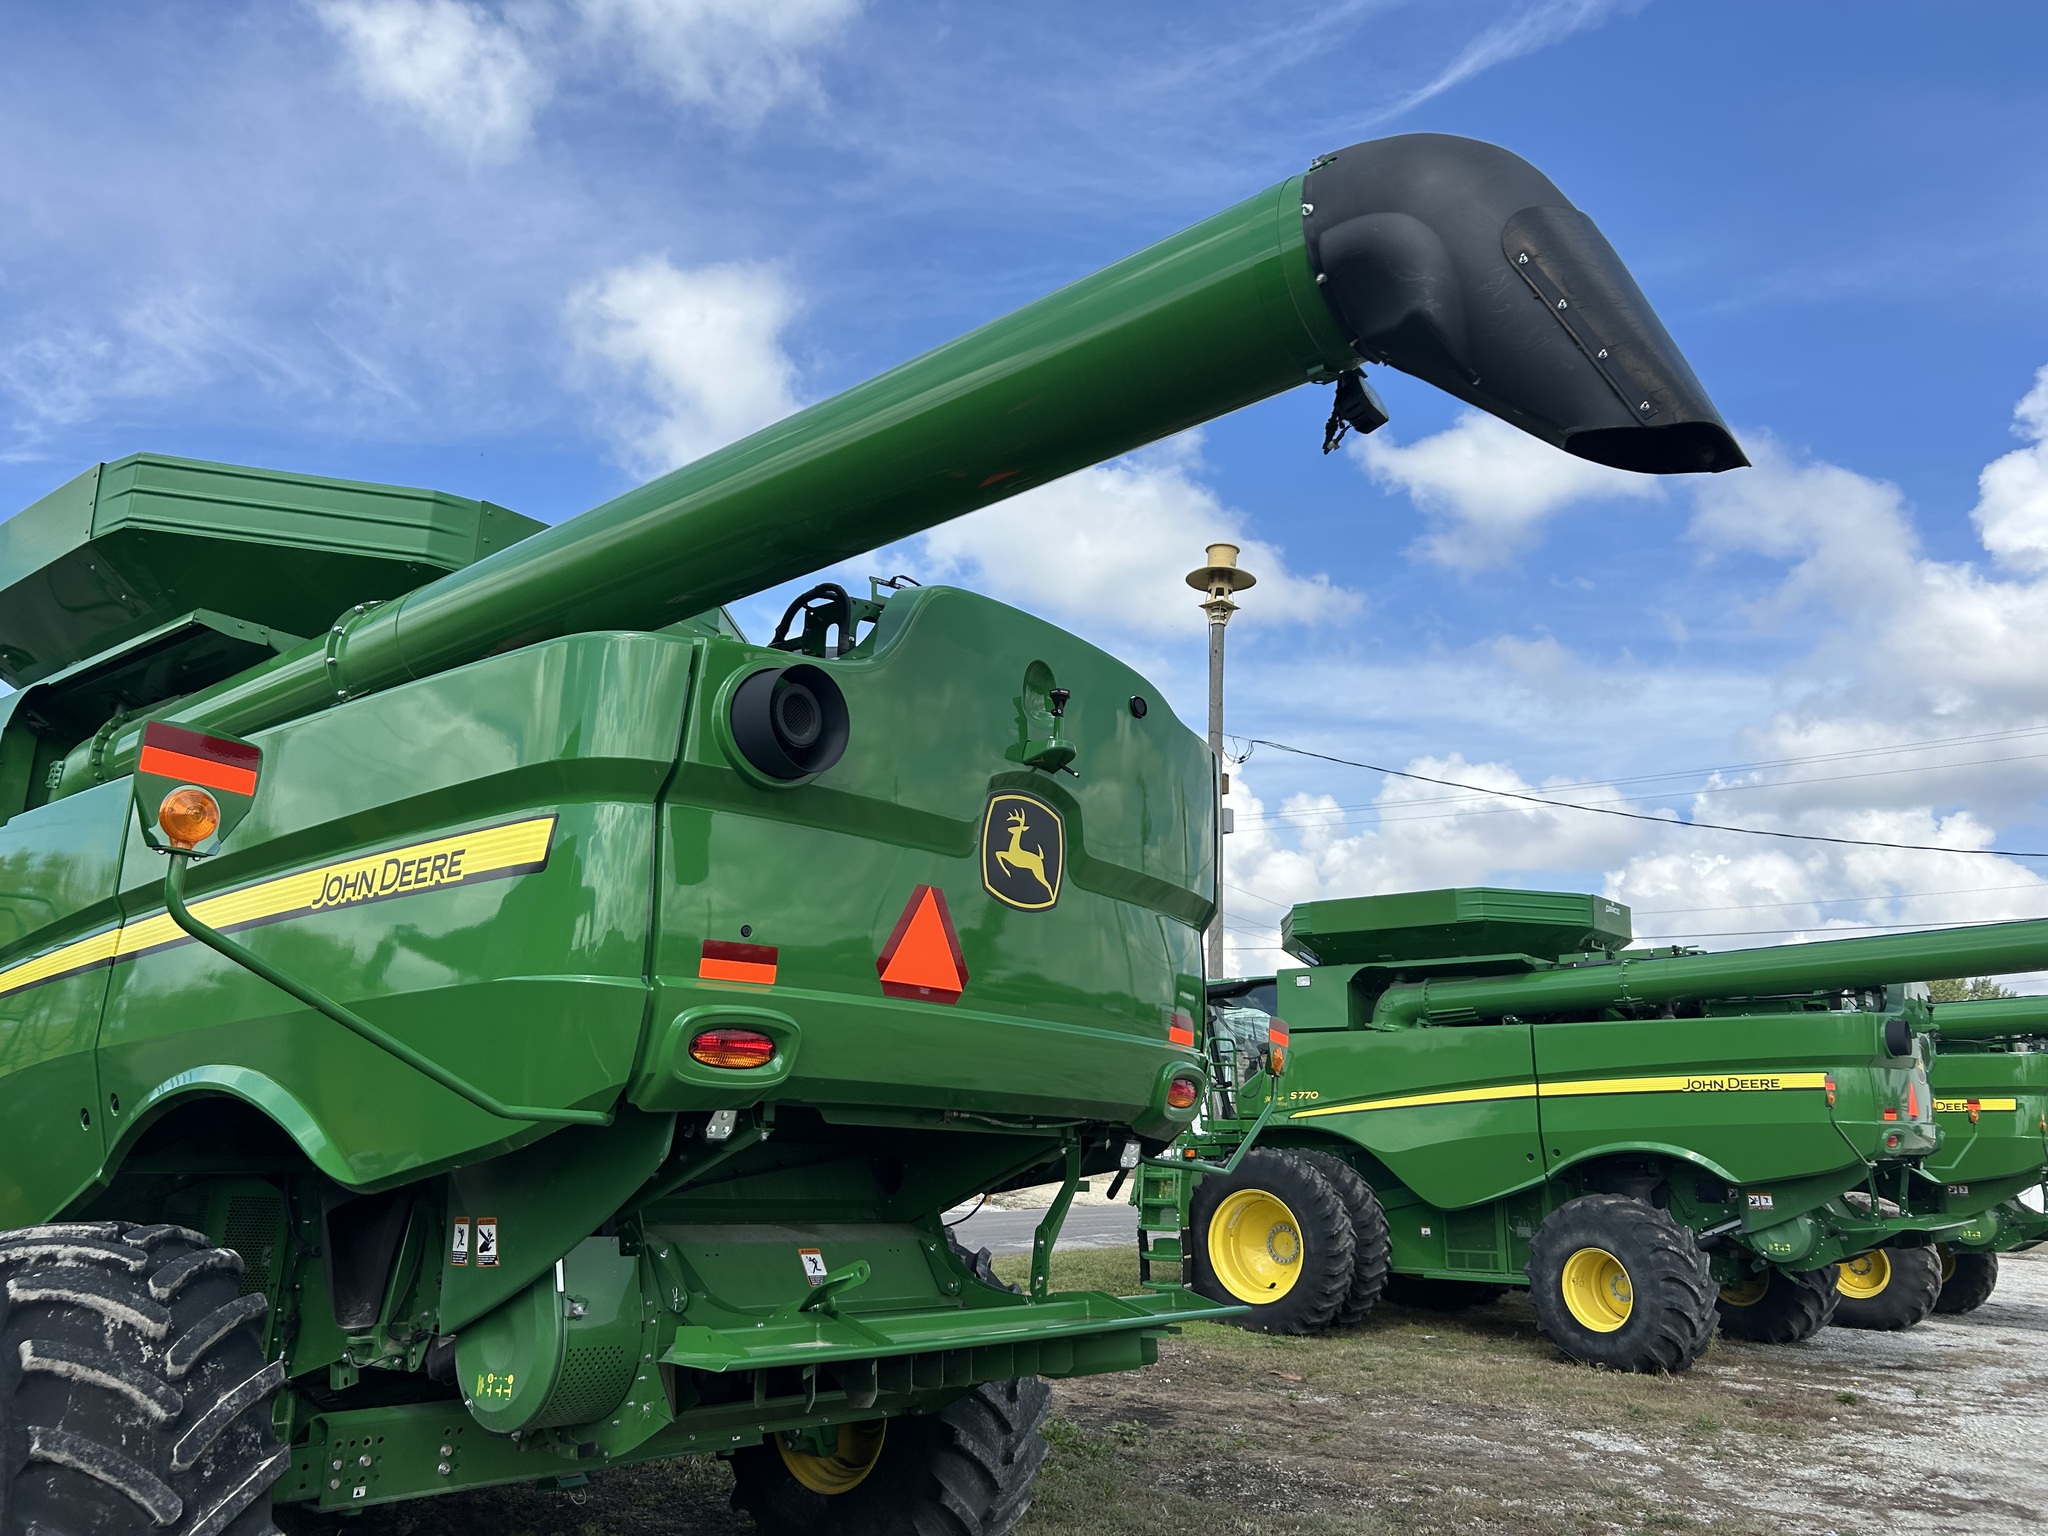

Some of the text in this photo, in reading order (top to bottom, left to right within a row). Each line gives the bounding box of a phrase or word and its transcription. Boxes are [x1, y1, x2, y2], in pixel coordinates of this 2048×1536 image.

[311, 849, 466, 905] JOHN DEERE
[1682, 1077, 1781, 1090] JOHN DEERE
[1289, 1091, 1319, 1100] S770
[1936, 1101, 1968, 1111] DEER
